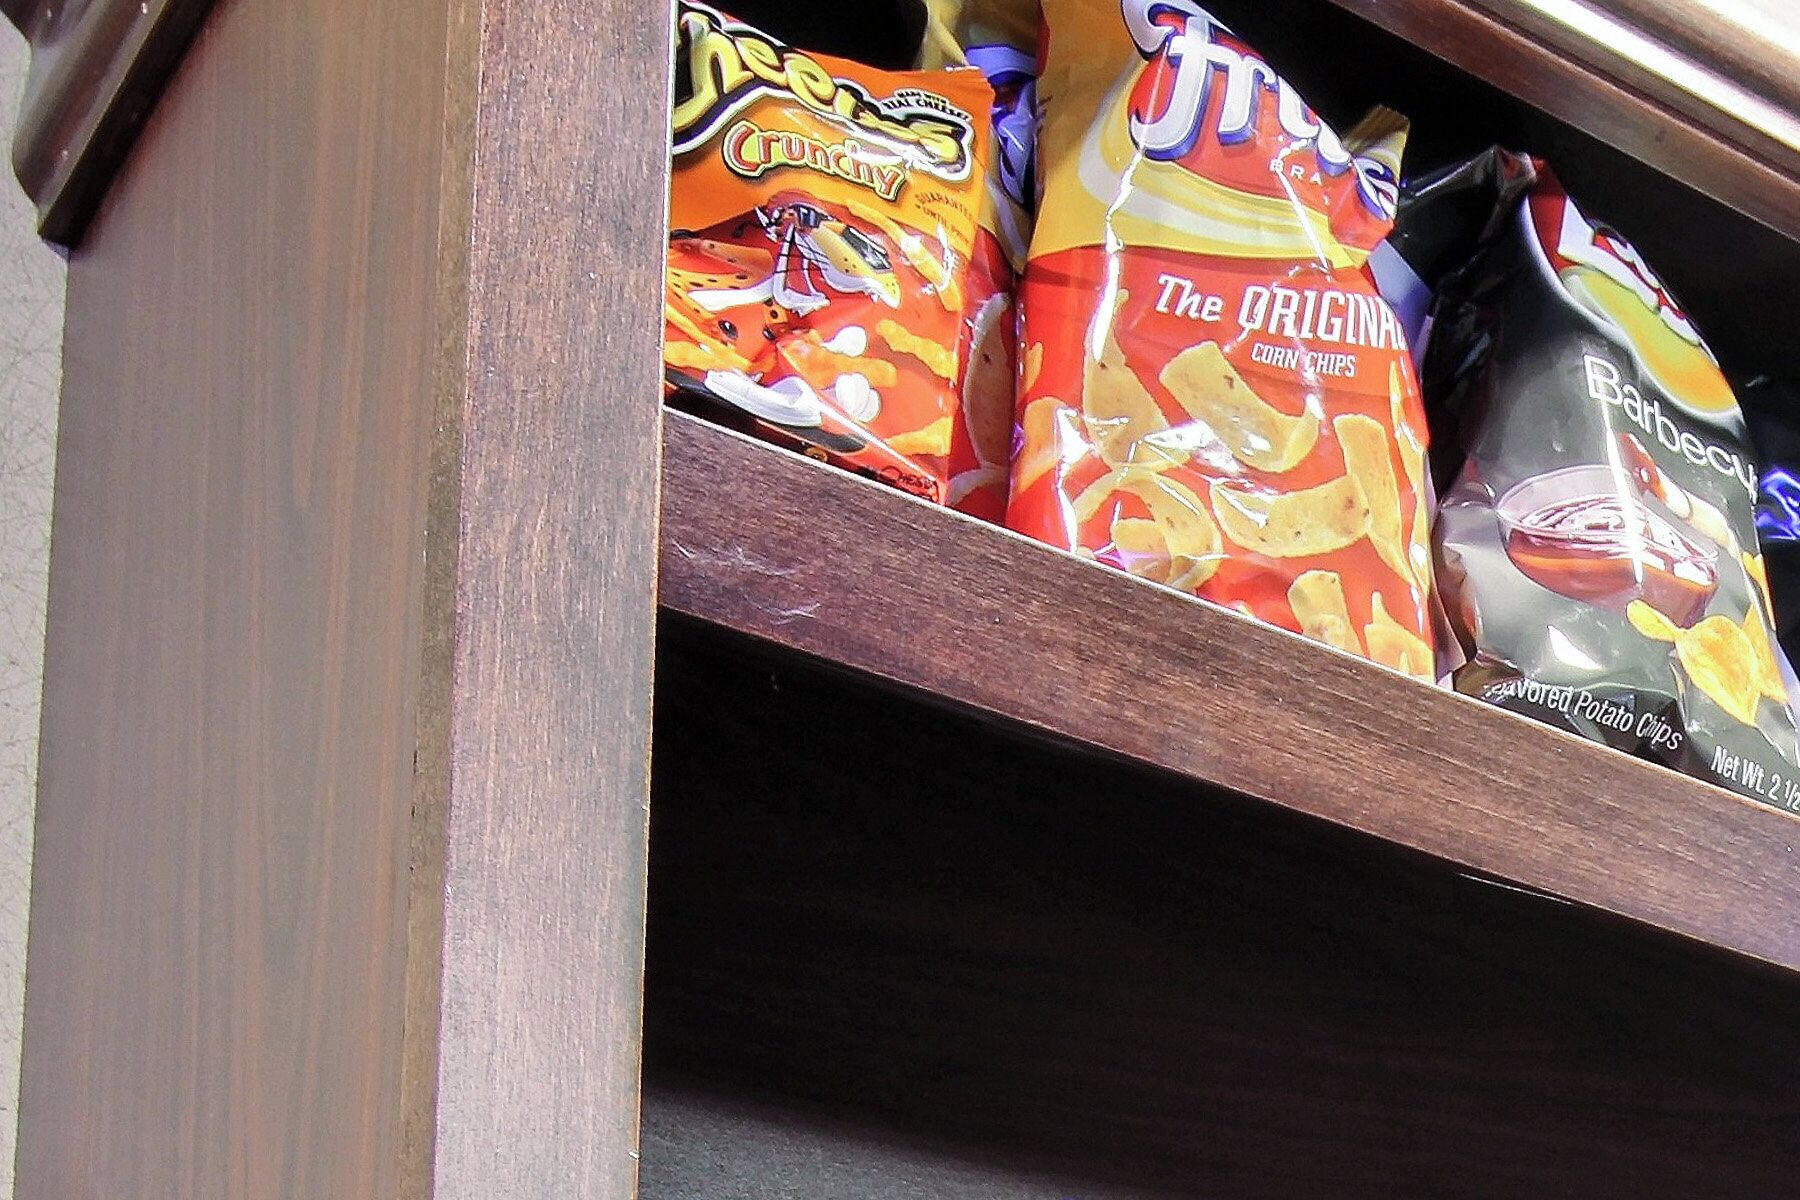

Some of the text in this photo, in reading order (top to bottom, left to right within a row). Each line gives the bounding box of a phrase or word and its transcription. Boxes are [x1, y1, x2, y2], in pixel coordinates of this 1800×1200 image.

[725, 121, 904, 199] Crunchy
[1157, 273, 1224, 323] The
[1251, 342, 1357, 378] CORN CHIPS
[1583, 354, 1758, 504] Barbecu
[1574, 690, 1634, 732] Potato
[1635, 712, 1683, 751] Chips
[1711, 745, 1741, 782] Net
[1741, 758, 1766, 795] Wt.
[1768, 773, 1782, 801] 2
